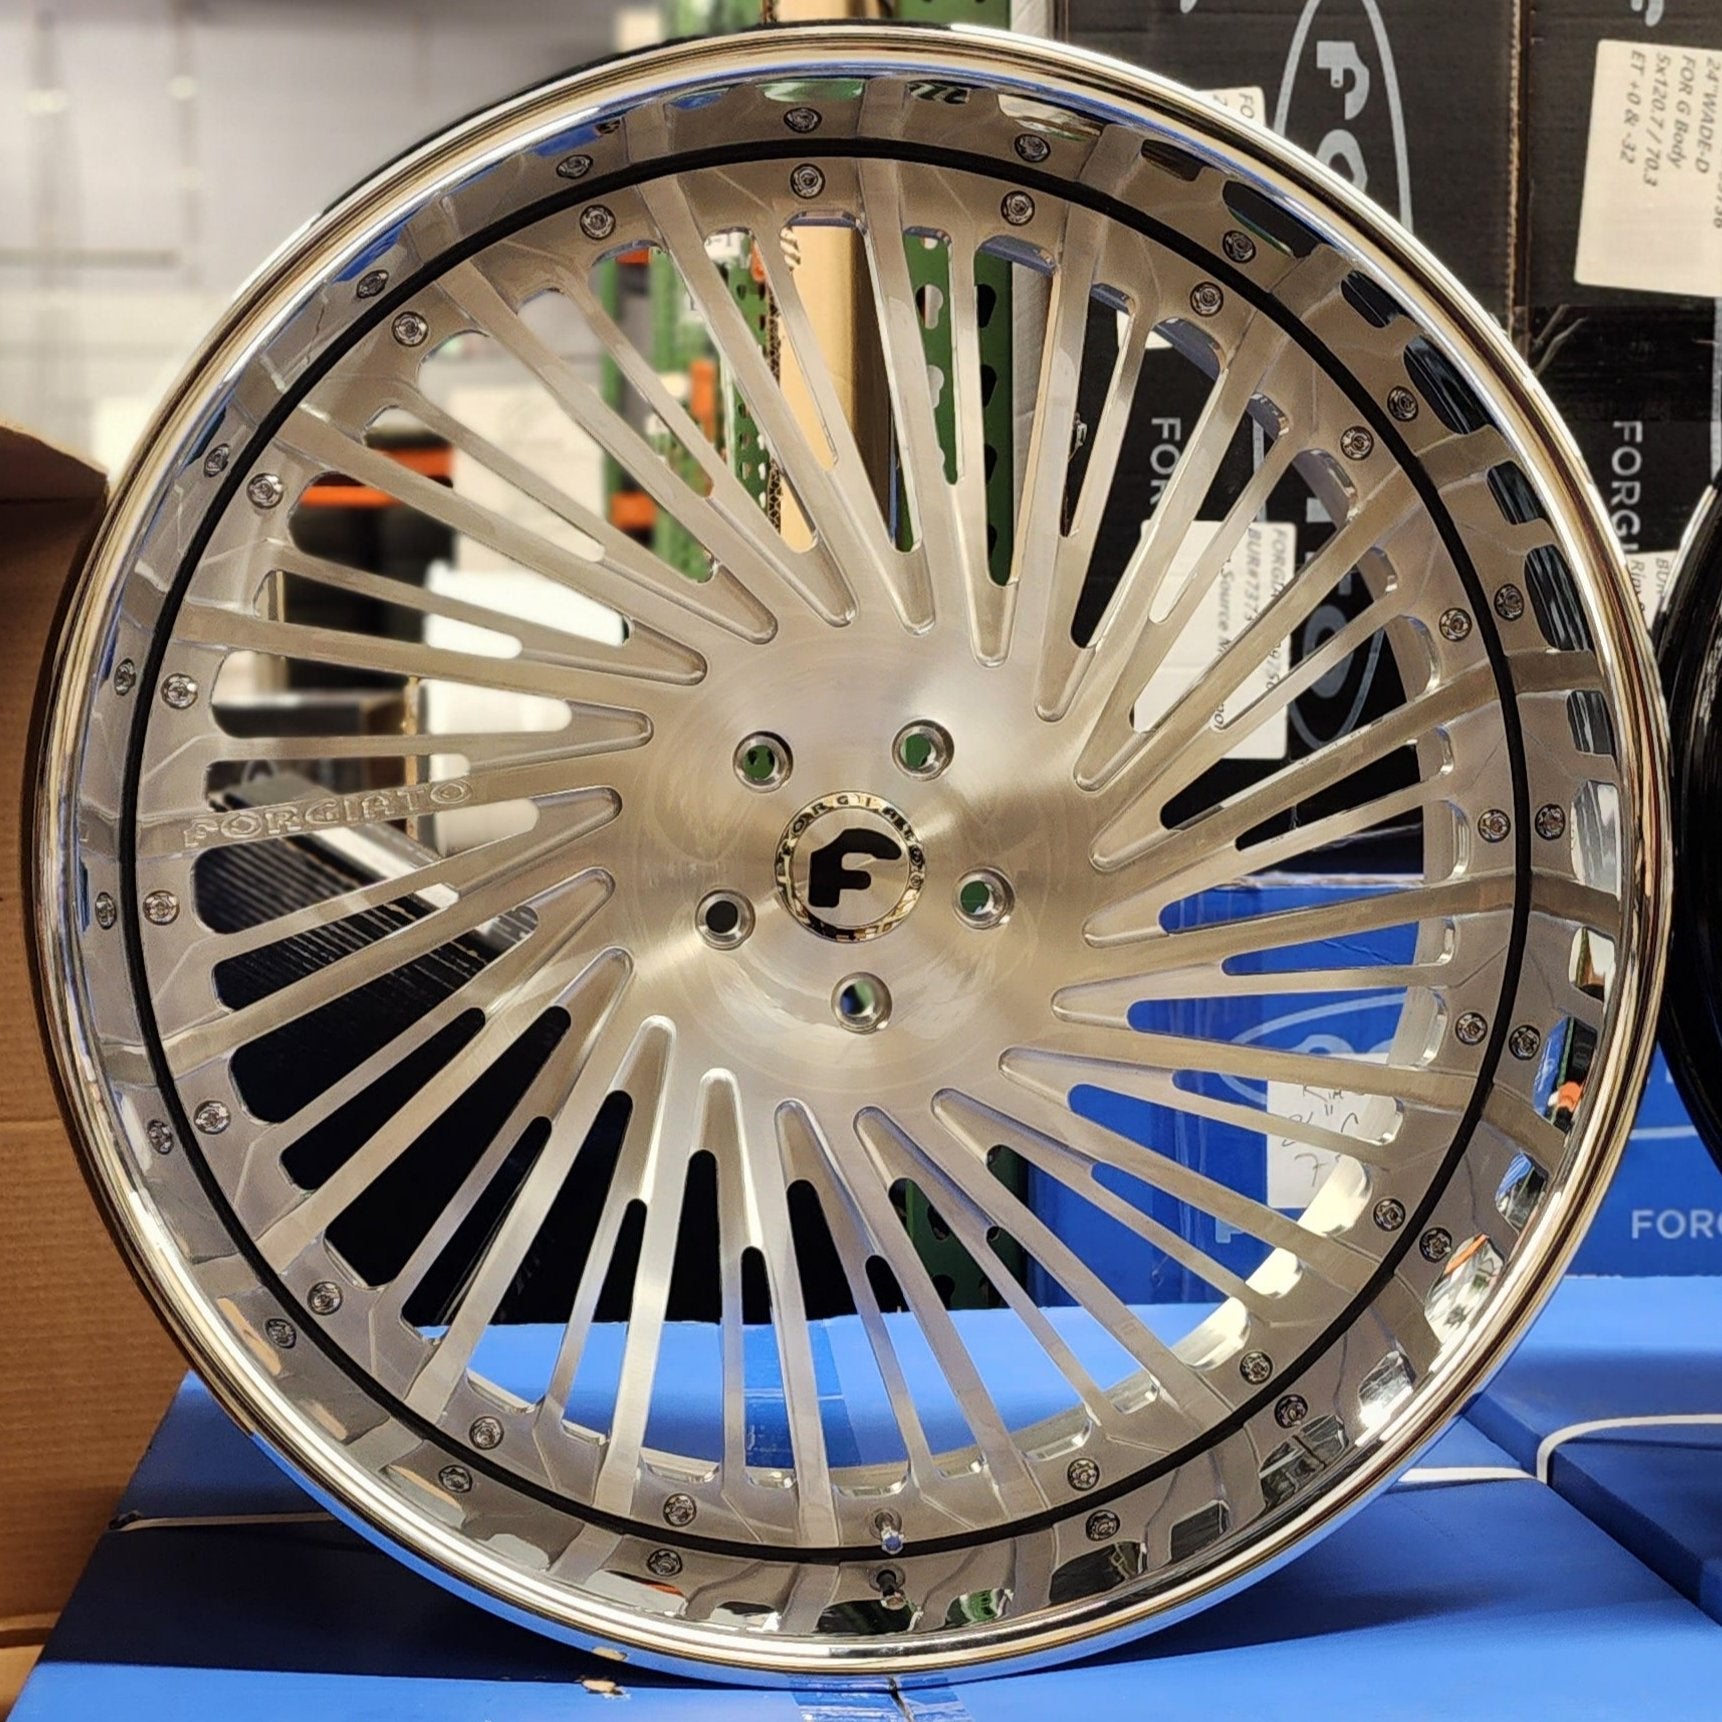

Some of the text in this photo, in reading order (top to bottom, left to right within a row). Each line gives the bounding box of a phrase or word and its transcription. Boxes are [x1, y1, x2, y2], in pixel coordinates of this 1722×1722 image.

[1631, 50, 1646, 75] ET
[1667, 54, 1697, 169] FOR G Body
[183, 779, 473, 848] FORGIATO
[1631, 1209, 1722, 1239] FOR
